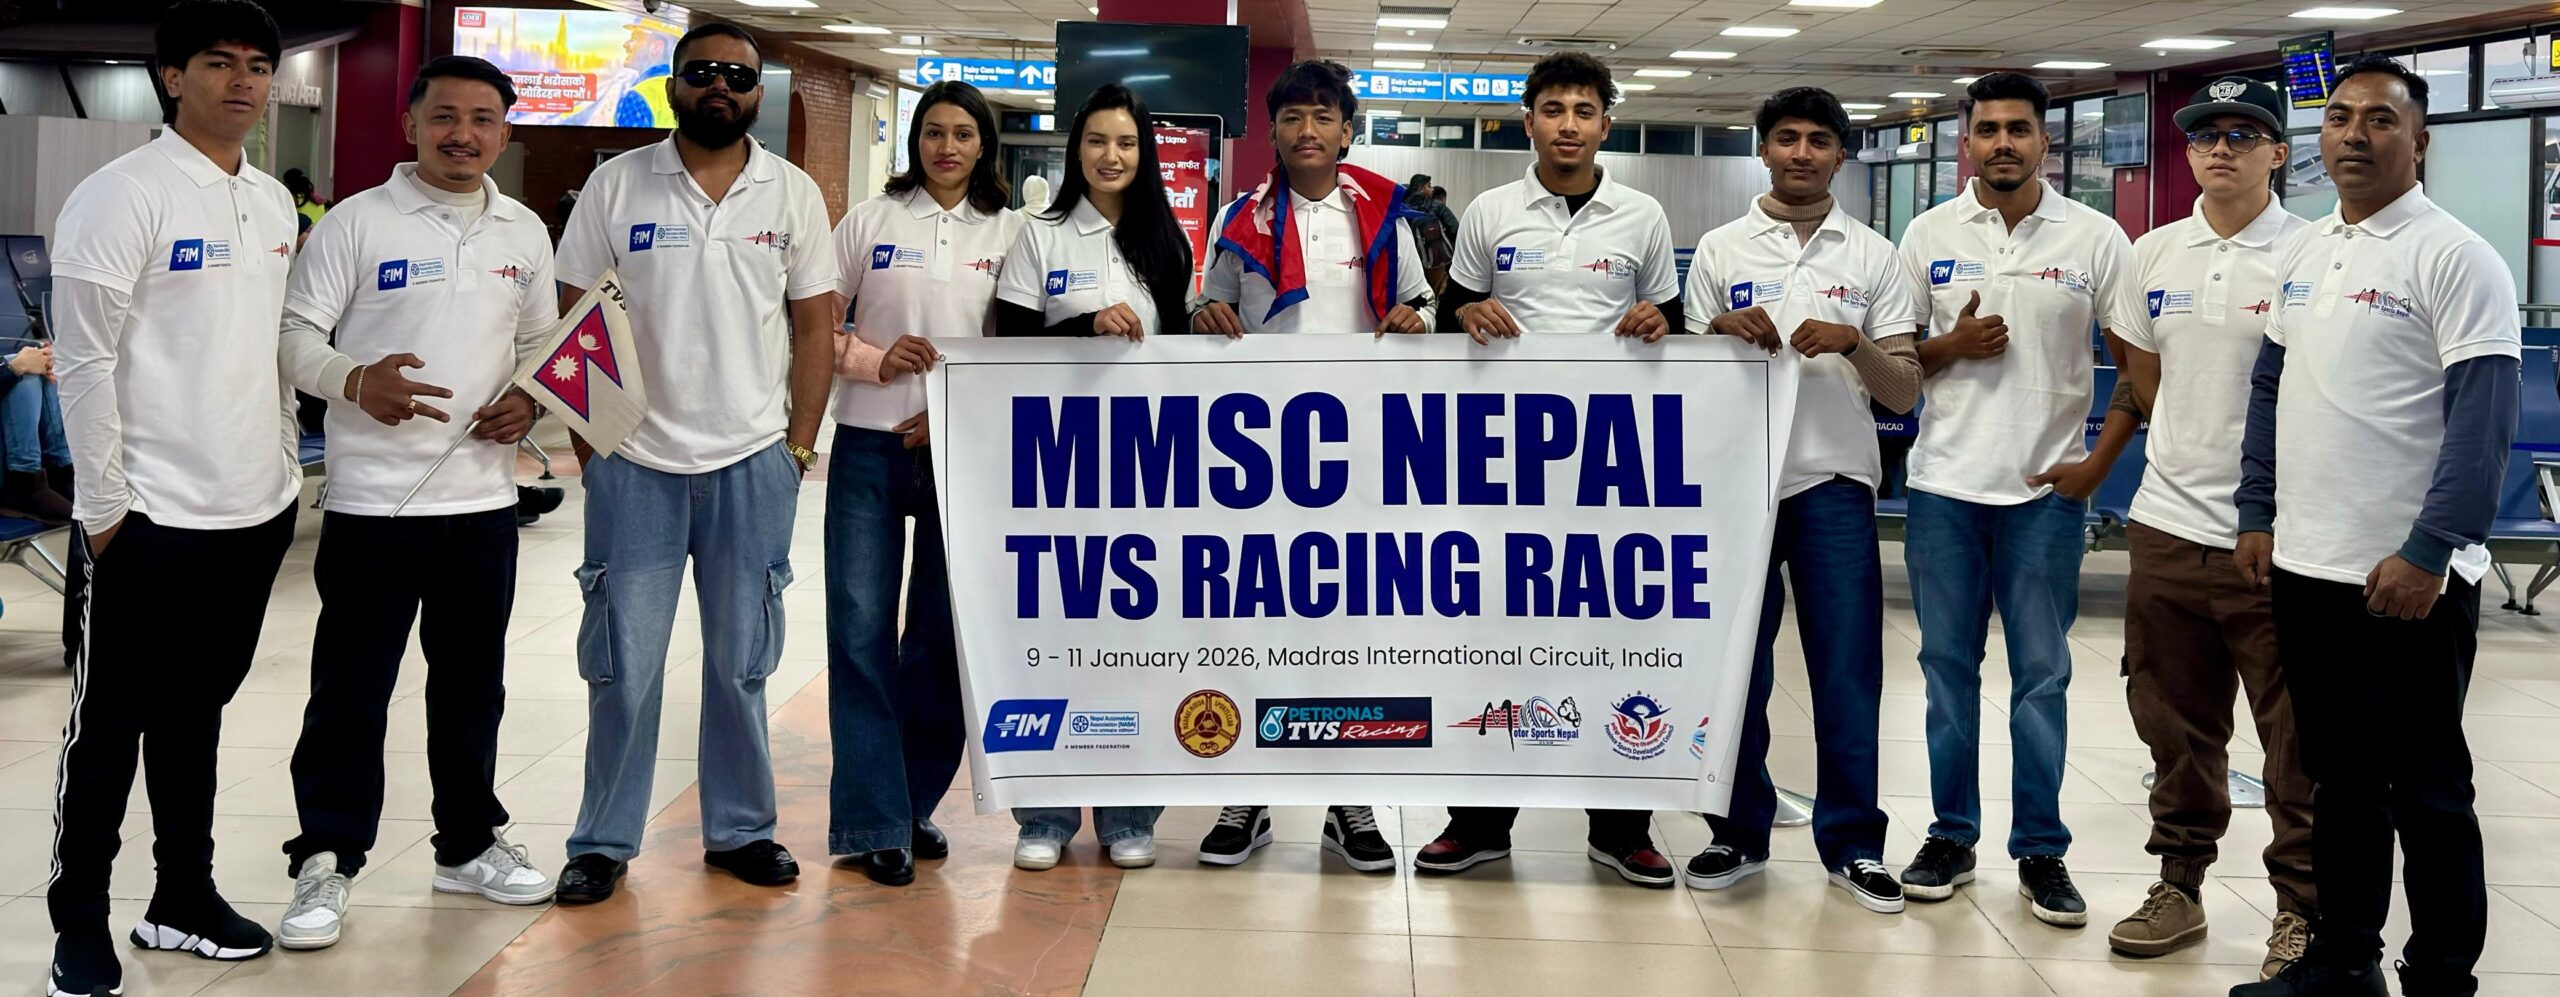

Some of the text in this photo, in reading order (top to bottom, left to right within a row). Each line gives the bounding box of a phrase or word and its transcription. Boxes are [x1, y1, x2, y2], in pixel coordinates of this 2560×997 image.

[1391, 78, 1407, 86] Baby
[633, 230, 650, 244] FIM
[176, 247, 199, 262] FIM
[874, 251, 889, 263] FIM
[381, 267, 403, 283] FIM
[1933, 266, 1950, 278] FIM
[1048, 277, 1064, 290] FIM
[1734, 289, 1749, 303] FIM
[1012, 392, 1702, 510] MMSC NEPAL
[1005, 531, 1711, 620] TVS RACING RACE
[1026, 647, 1040, 667] 9
[1067, 647, 1083, 667] 11
[1090, 647, 1189, 673] January
[1197, 647, 1260, 670] 2026,
[1268, 645, 1359, 666] Madras
[1366, 644, 1521, 666] International
[1530, 646, 1614, 670] Circuit,
[1621, 647, 1684, 668] India
[1288, 706, 1384, 721] PETRONAS
[994, 713, 1052, 738] FIM
[1287, 721, 1427, 741] TVS Racing
[1531, 727, 1555, 740] Sports
[1557, 728, 1579, 740] Nepal
[1604, 724, 1618, 745] Province
[1616, 742, 1632, 754] Sports
[1632, 740, 1665, 755] Development
[1662, 725, 1675, 743] Council
